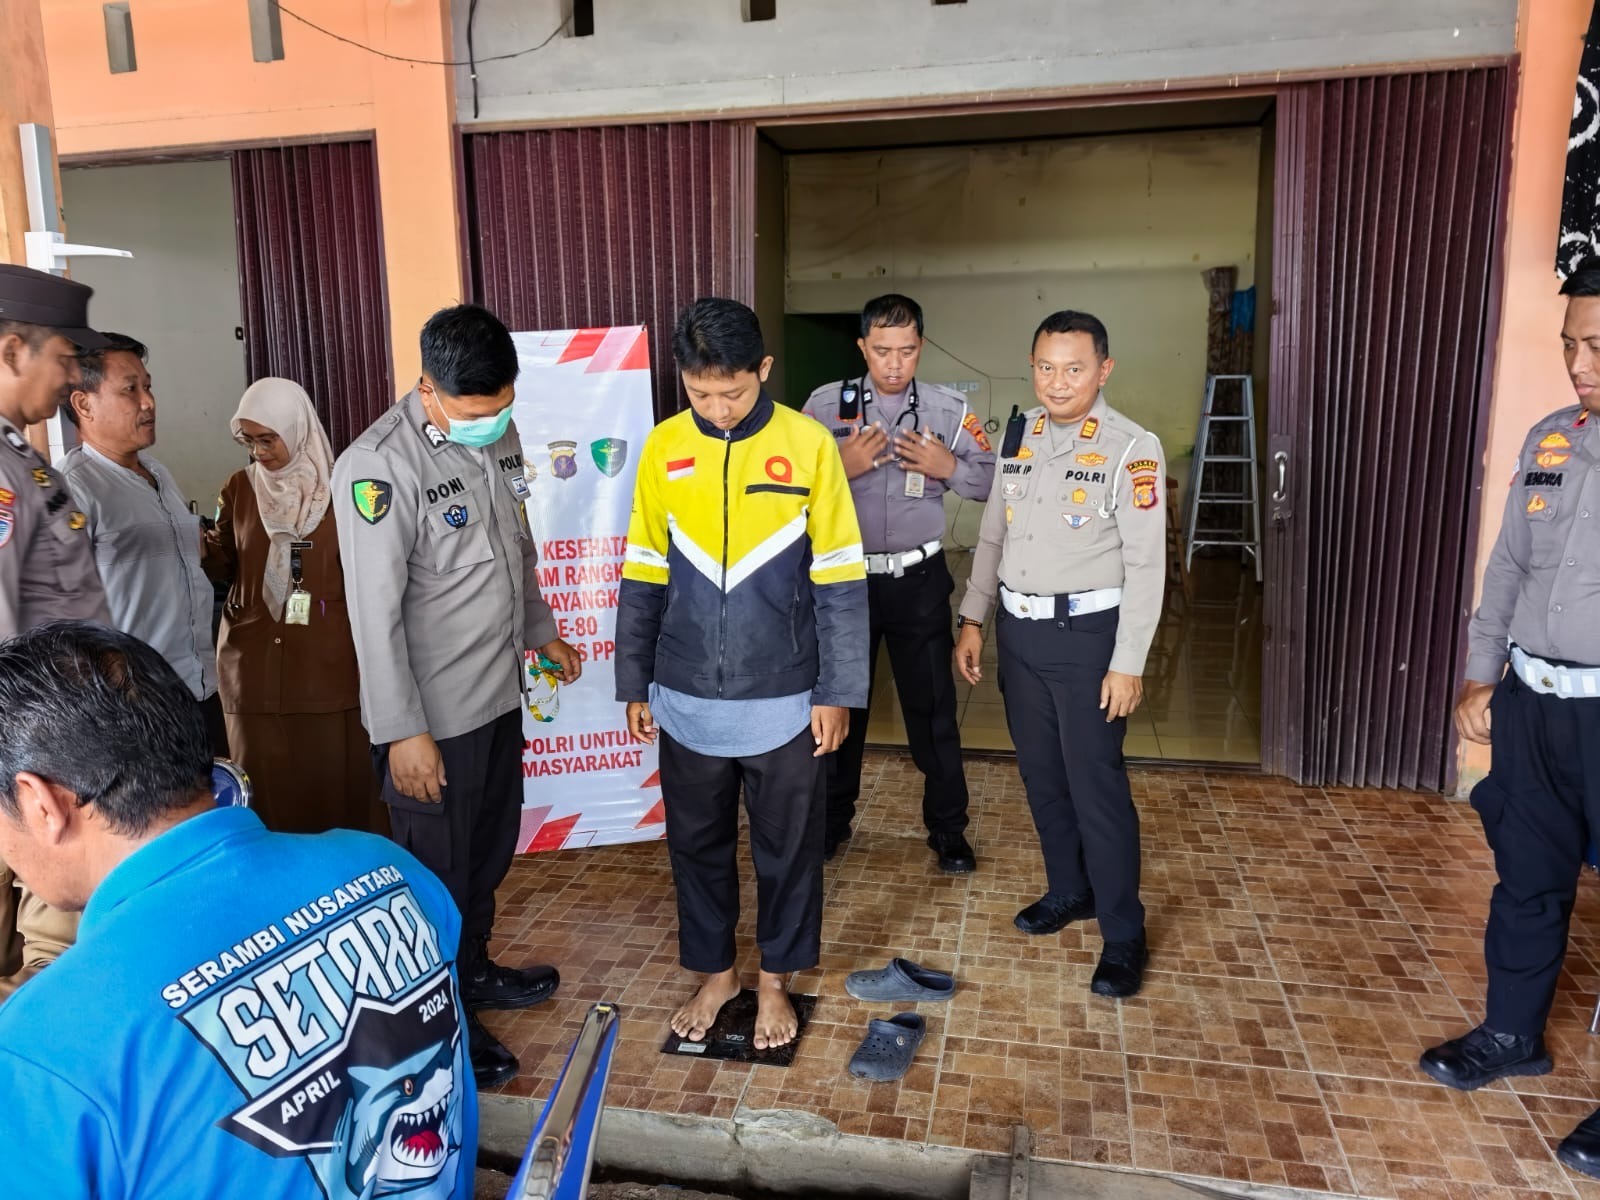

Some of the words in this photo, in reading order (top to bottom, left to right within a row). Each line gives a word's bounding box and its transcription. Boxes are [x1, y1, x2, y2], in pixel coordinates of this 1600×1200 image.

[1023, 465, 1032, 475] IP
[1065, 470, 1106, 484] POLRI
[426, 477, 465, 504] DONI
[543, 536, 627, 561] KESEHATA
[534, 567, 559, 588] AM
[565, 562, 624, 586] RANGK
[544, 588, 618, 612] AYANGK
[558, 616, 598, 638] E-80
[592, 640, 615, 661] PP
[522, 735, 574, 756] POLRI
[523, 750, 643, 778] MASYARAKAT
[161, 925, 286, 1009] SERAMBI
[283, 865, 404, 936] NUSANTARA
[217, 892, 442, 1080] SETARA
[419, 989, 450, 1024] 2024
[280, 1070, 341, 1125] APRIL
